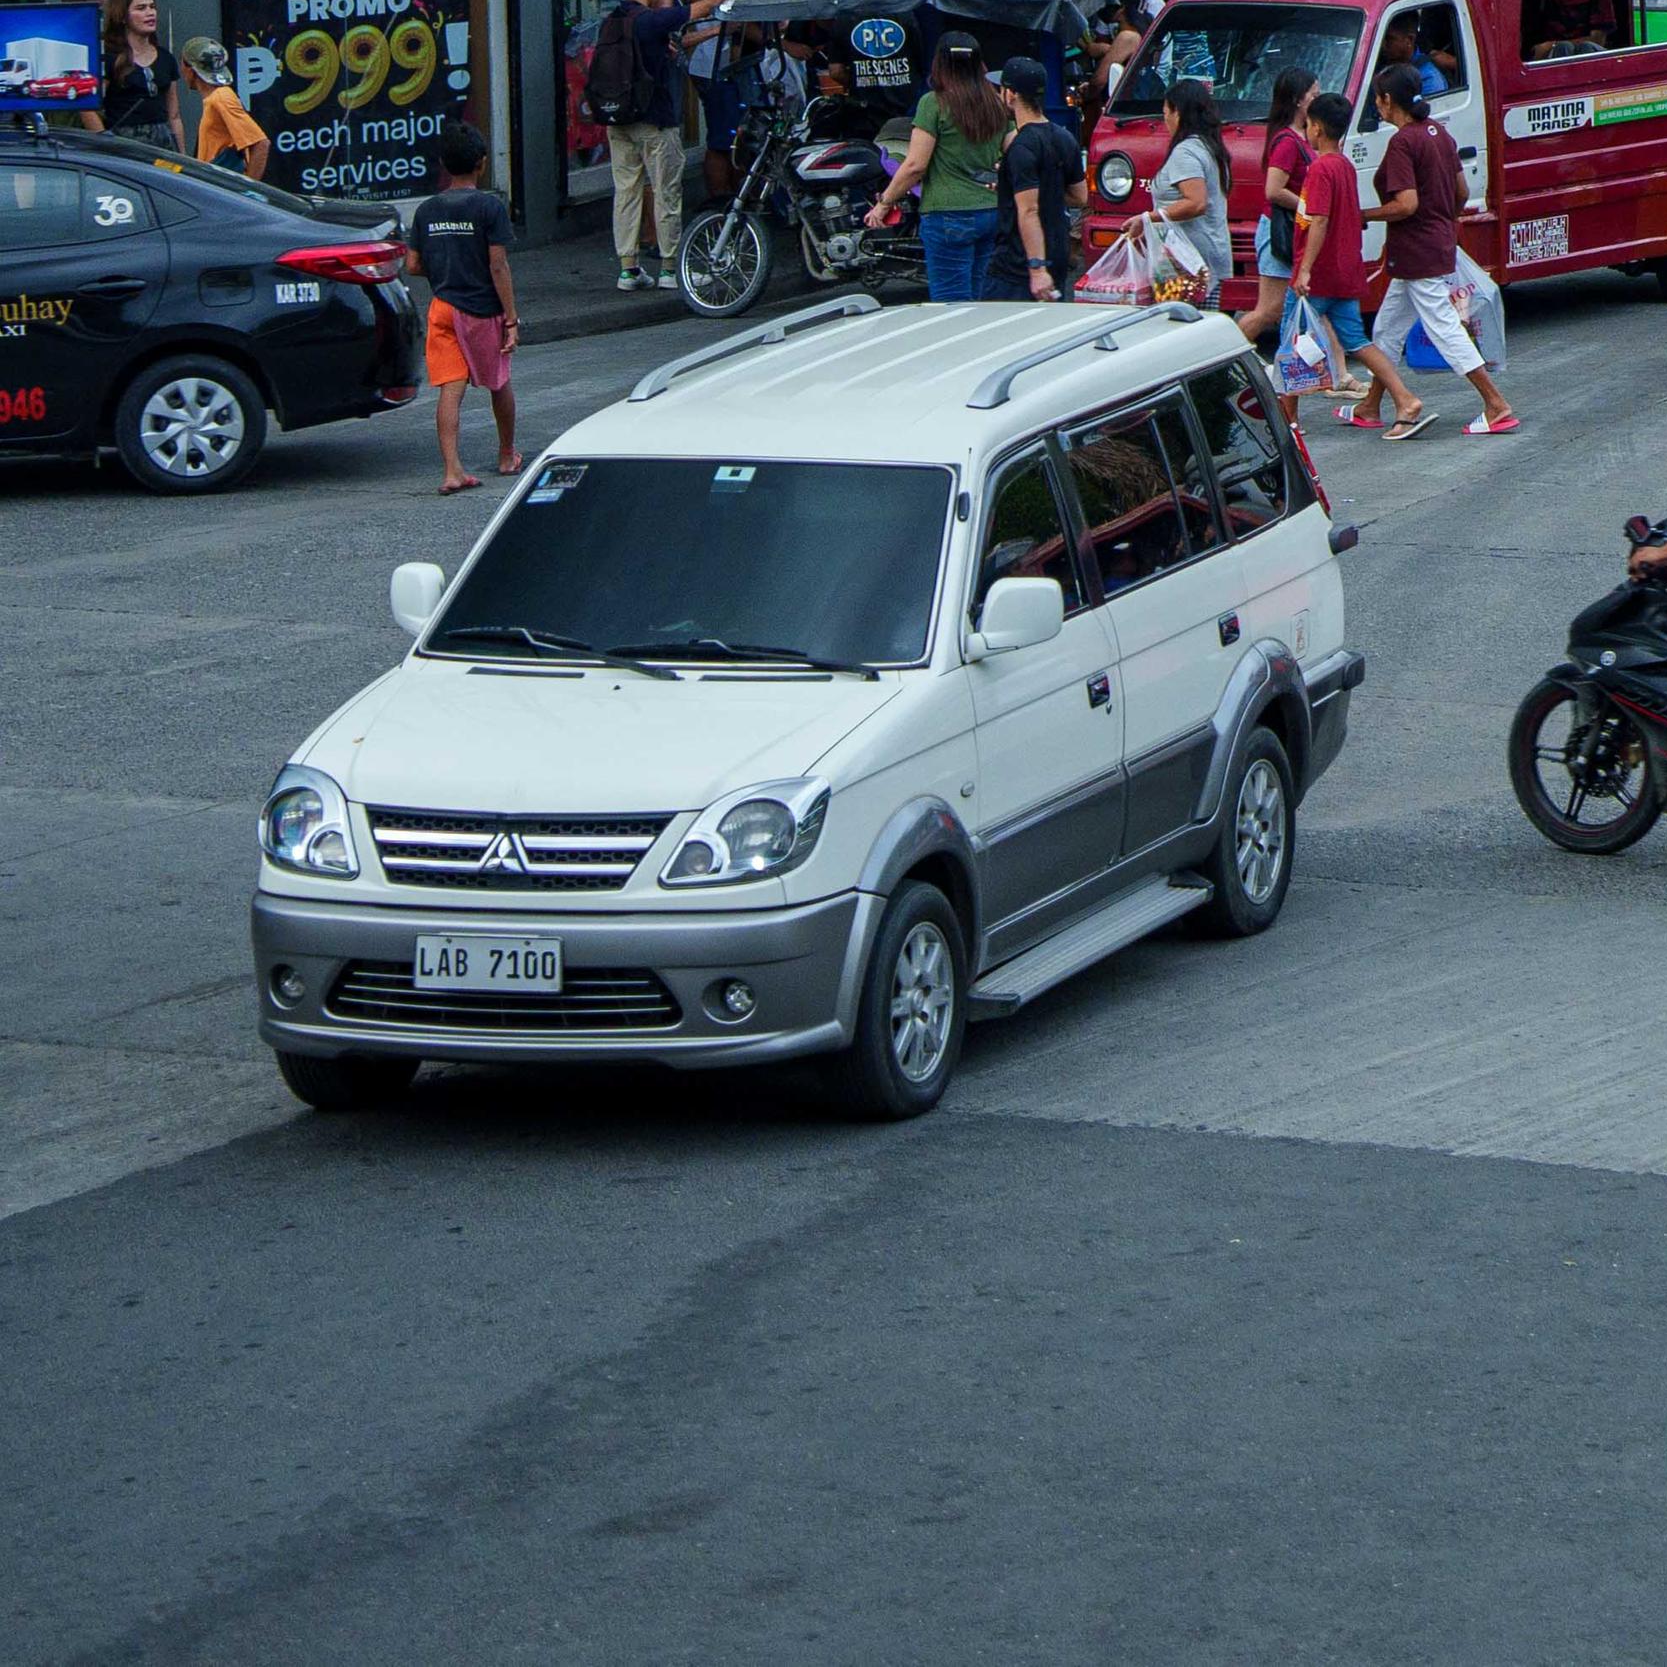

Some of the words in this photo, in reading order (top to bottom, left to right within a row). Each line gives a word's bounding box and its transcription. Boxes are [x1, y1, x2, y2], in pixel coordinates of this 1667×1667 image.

[853, 60, 873, 78] THE
[873, 57, 910, 76] SCENES
[1527, 102, 1585, 122] MATINA
[277, 117, 350, 153] each
[362, 111, 446, 150] major
[301, 155, 427, 191] services
[276, 284, 298, 305] KAR
[418, 943, 471, 978] LAB
[488, 947, 558, 983] 7100
